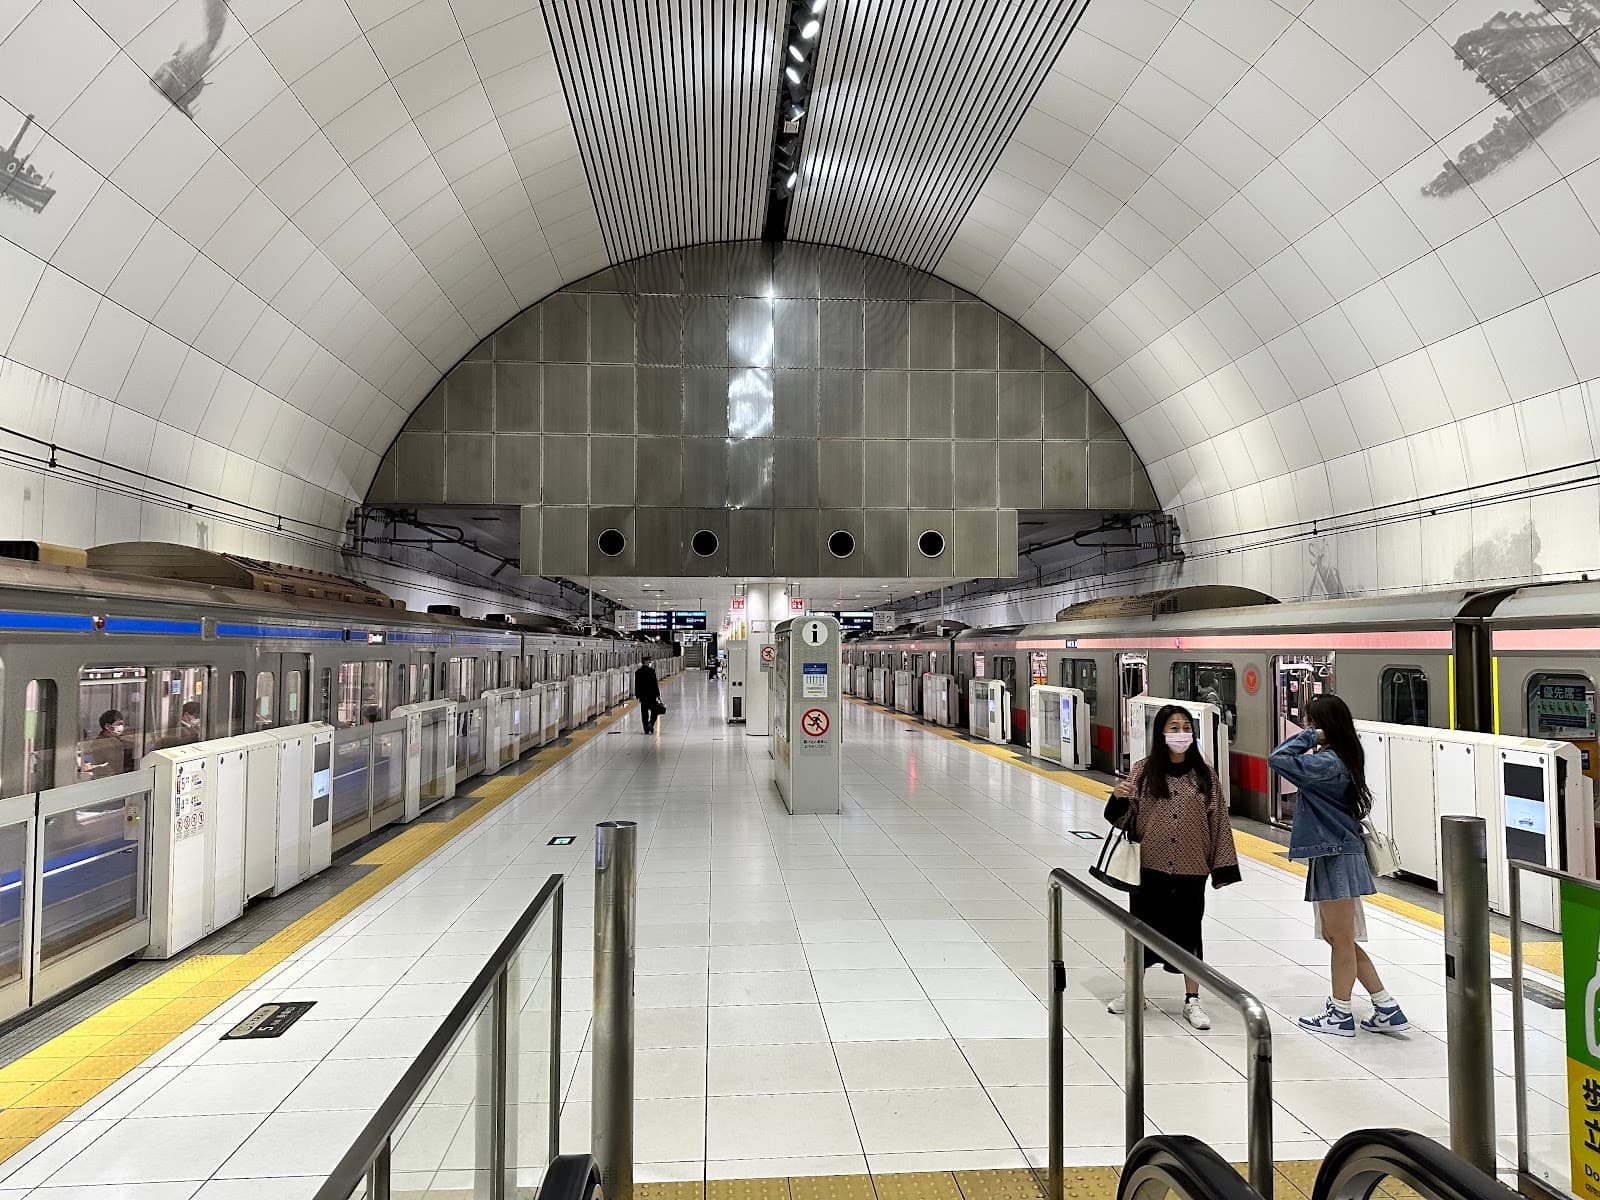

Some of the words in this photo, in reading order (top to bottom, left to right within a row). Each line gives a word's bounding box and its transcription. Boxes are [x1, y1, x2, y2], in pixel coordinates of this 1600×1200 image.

[886, 616, 892, 624] 2
[1543, 686, 1575, 699] 優先席
